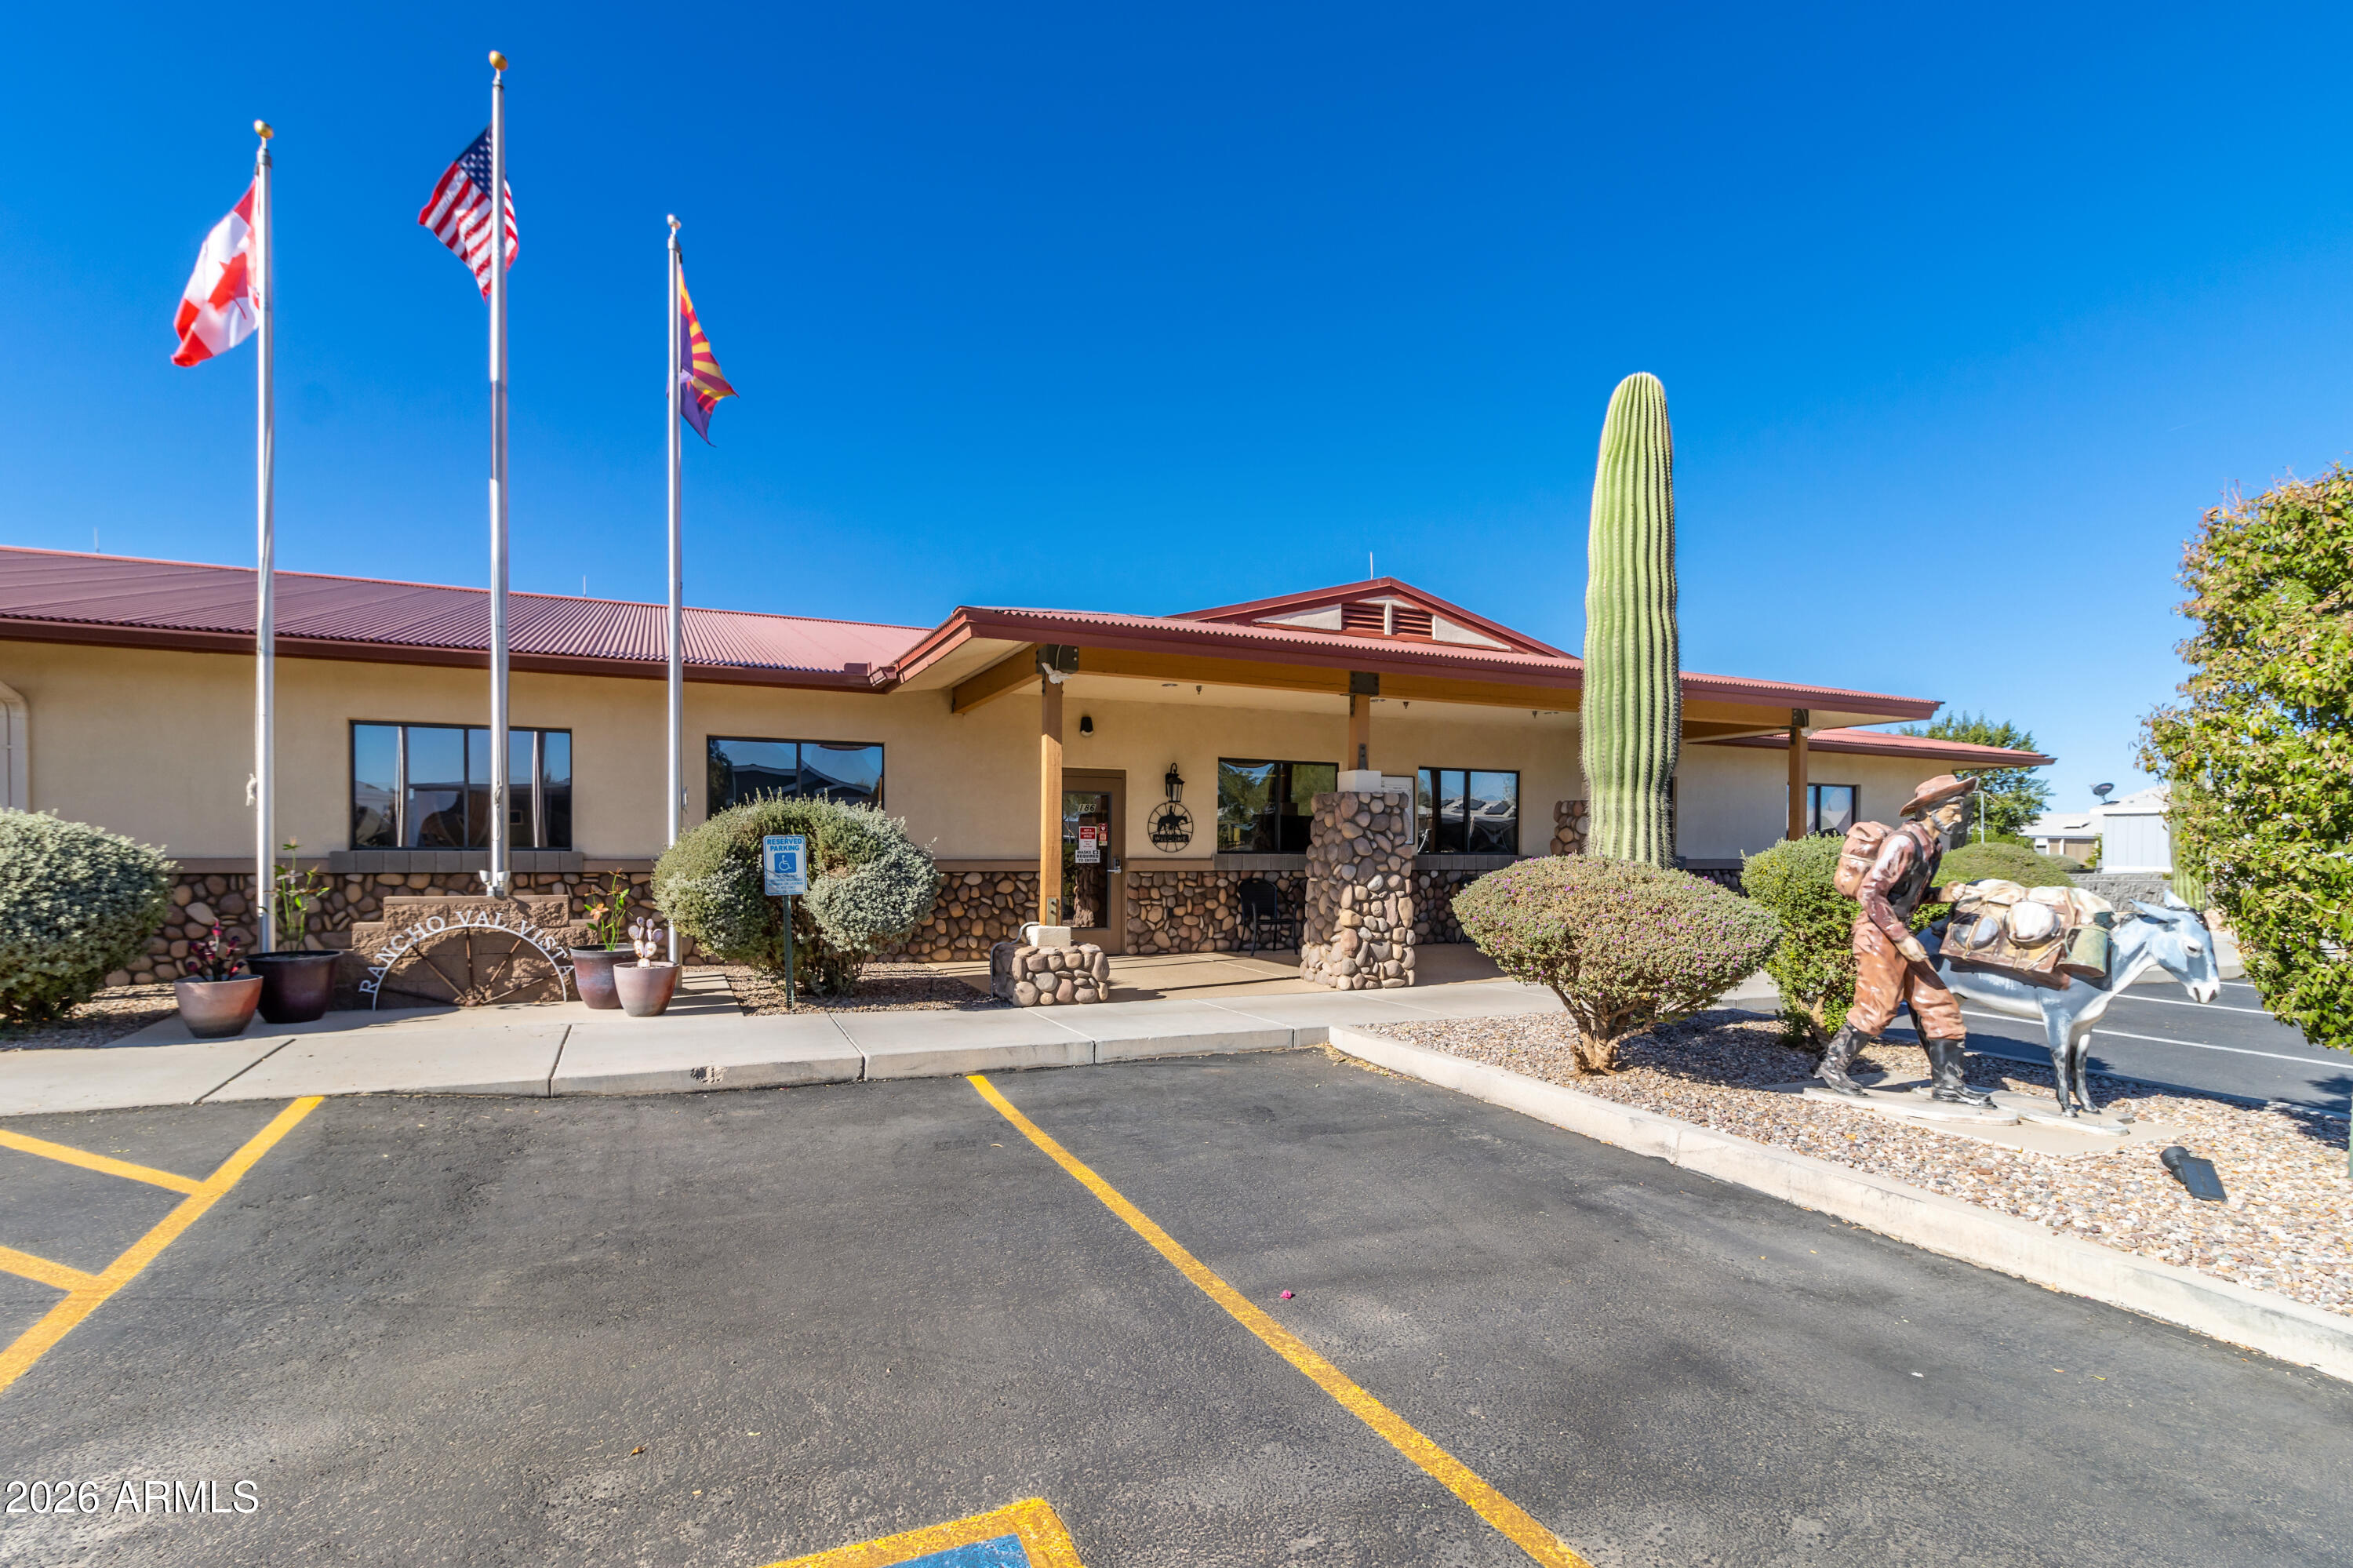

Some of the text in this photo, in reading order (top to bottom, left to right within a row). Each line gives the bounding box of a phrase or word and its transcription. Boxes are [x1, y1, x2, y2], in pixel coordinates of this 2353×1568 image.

[358, 910, 575, 995] RANCHO VAL VISTA
